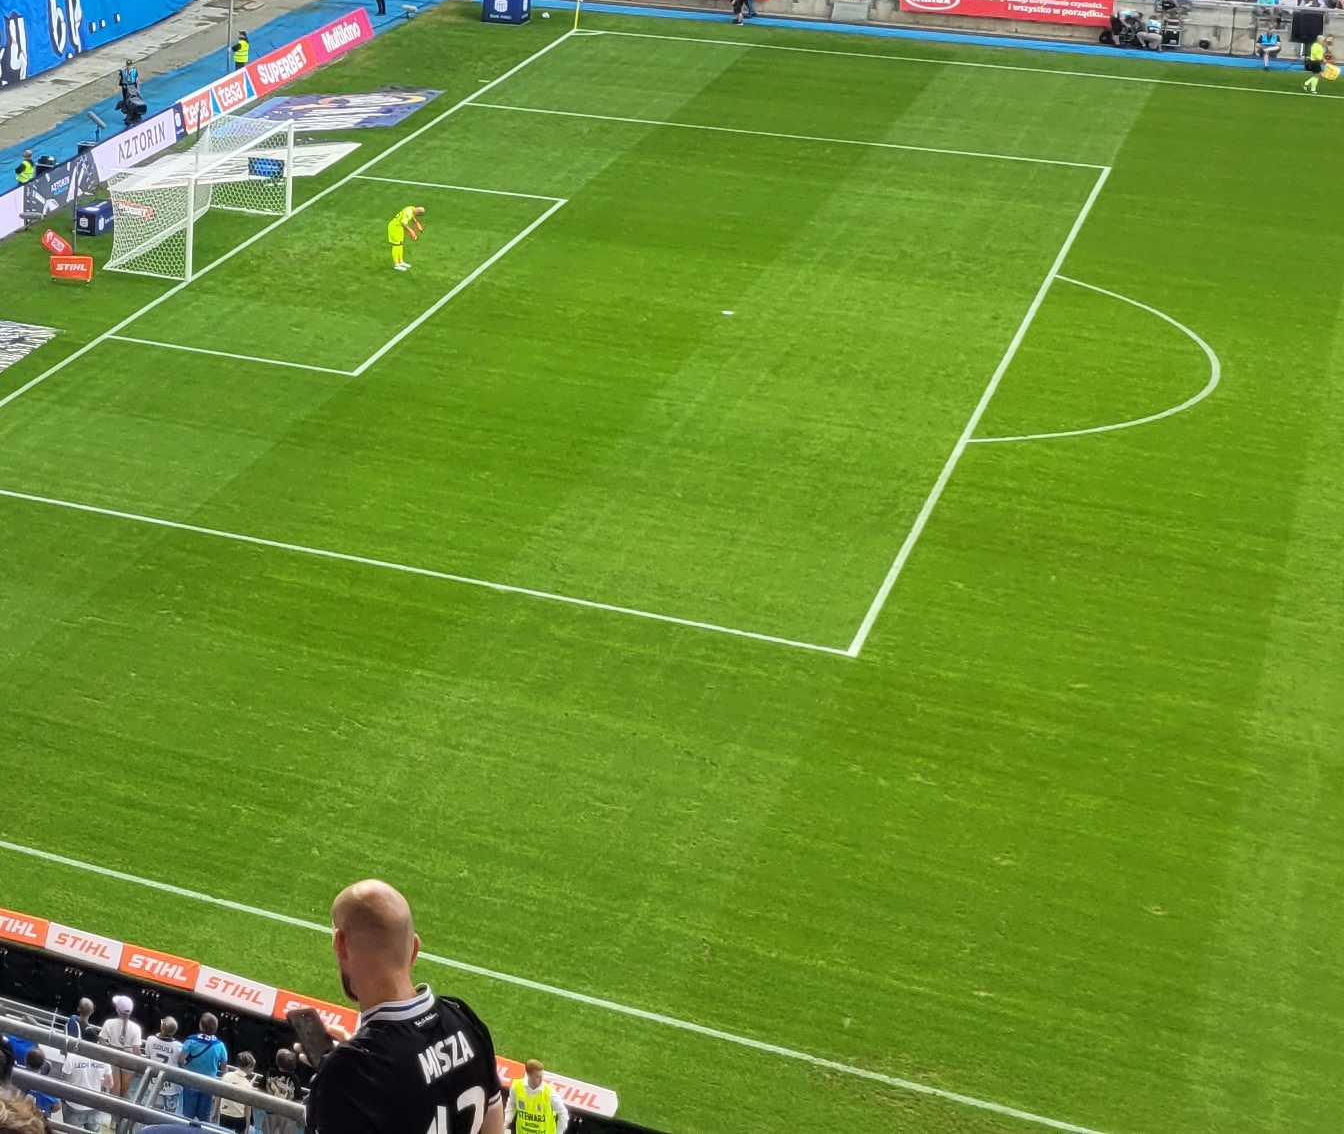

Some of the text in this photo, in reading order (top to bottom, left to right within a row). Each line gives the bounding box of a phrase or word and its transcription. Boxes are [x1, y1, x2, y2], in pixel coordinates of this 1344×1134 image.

[320, 18, 361, 53] Multikino
[257, 42, 308, 85] SUPERBET
[218, 80, 244, 107] tesa
[183, 99, 210, 126] tesa
[118, 121, 166, 164] AZTORIN
[55, 263, 88, 272] STIHL
[54, 932, 111, 960] STIHL
[128, 953, 187, 982] STIHL
[205, 976, 264, 1006] STIHL
[283, 1000, 345, 1029] SHL
[418, 1030, 474, 1085] MISZA
